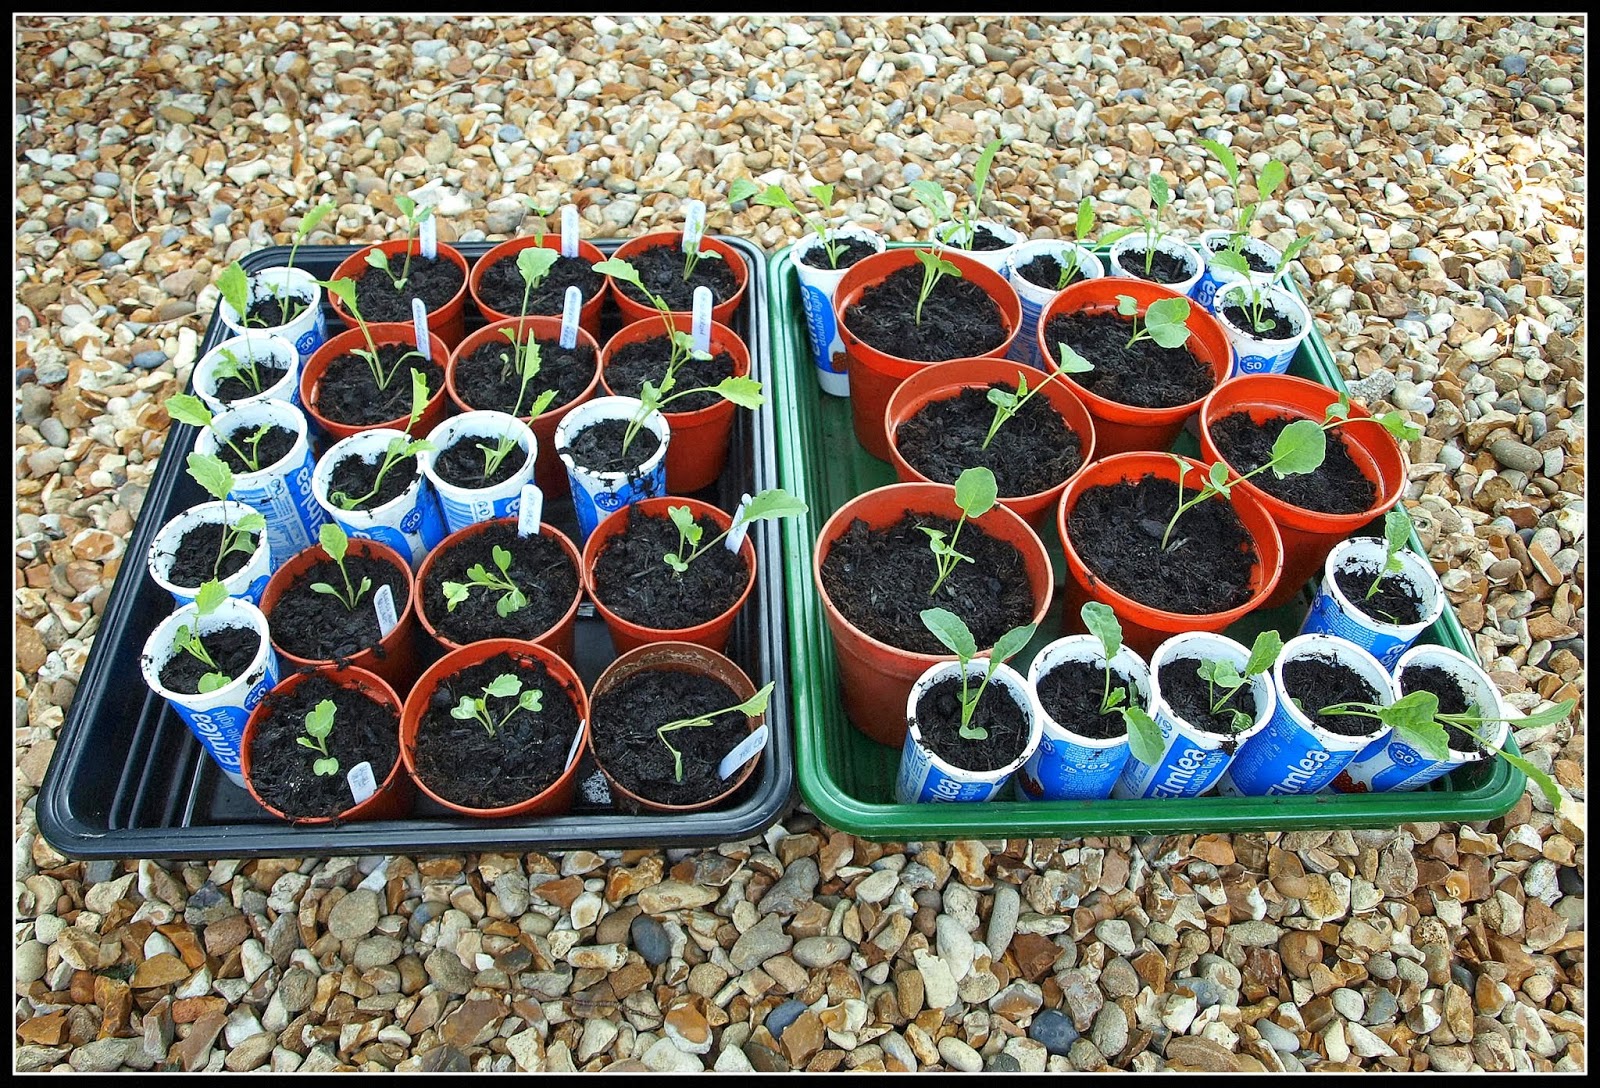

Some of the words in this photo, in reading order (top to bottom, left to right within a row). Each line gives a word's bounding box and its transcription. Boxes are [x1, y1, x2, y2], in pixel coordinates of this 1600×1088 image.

[301, 337, 314, 351] 50
[1246, 361, 1262, 370] 50
[406, 512, 420, 529] 50
[190, 713, 242, 766] Elmlea
[1394, 750, 1415, 764] 50
[1150, 748, 1207, 798] Elmlea
[931, 778, 963, 802] lea
